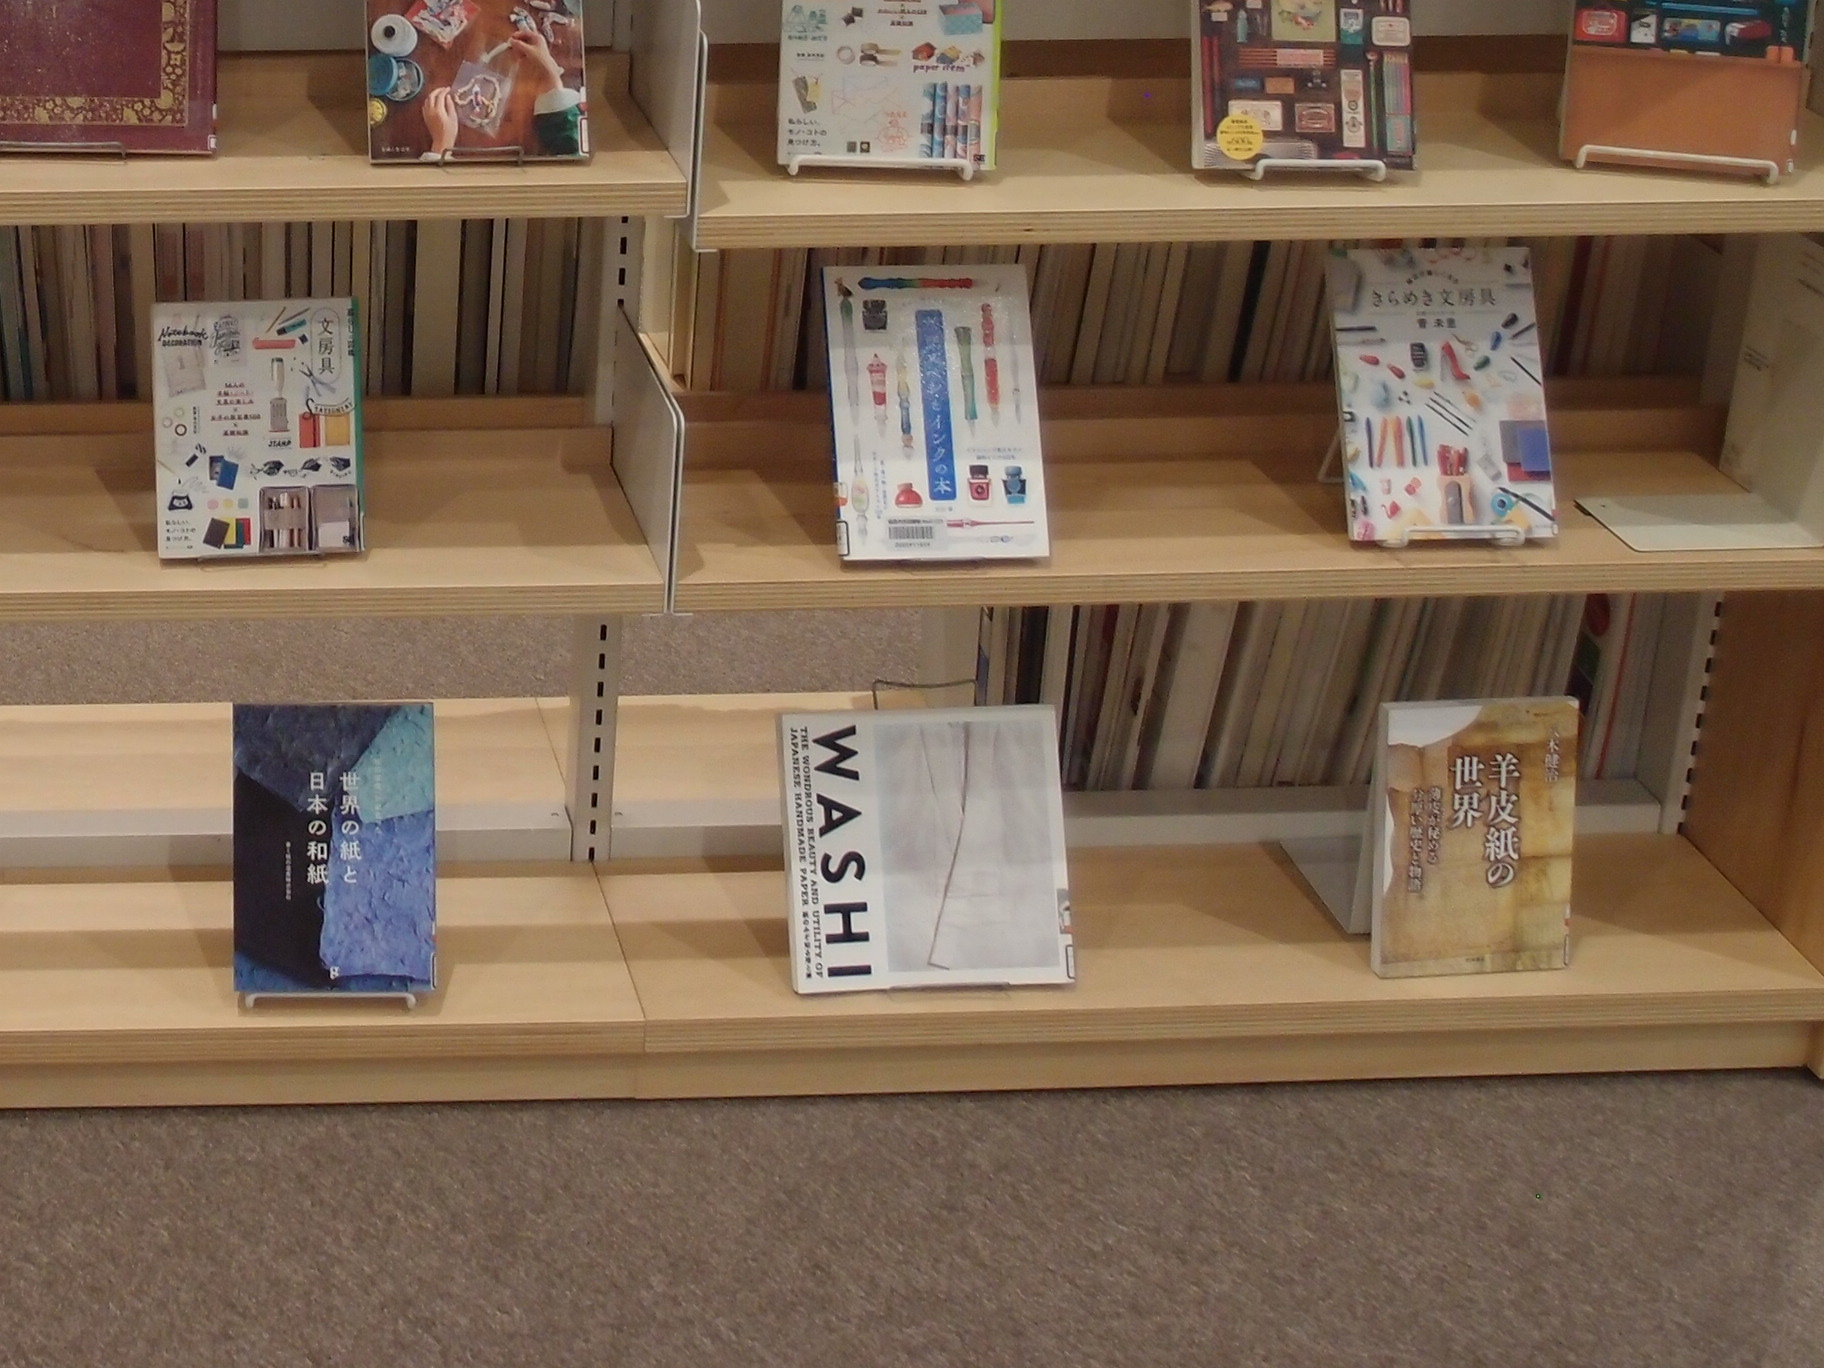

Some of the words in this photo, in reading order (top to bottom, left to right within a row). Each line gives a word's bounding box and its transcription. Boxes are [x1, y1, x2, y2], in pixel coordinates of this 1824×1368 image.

[1371, 288, 1497, 308] きらめき文房具
[317, 317, 336, 375] 文房具
[789, 727, 801, 789] JAPANESE
[799, 726, 808, 750] THE
[801, 754, 814, 824] WONDROUS
[1449, 755, 1486, 829] 世界
[306, 771, 329, 885] 日本の和紙
[339, 771, 363, 884] 世界の紙と
[794, 792, 807, 863] HANDMADE
[1485, 752, 1521, 889] 羊皮紙の
[807, 827, 818, 875] BEAUTY
[811, 724, 873, 979] WASHI
[799, 867, 809, 907] PAPER
[810, 879, 820, 906] AND
[812, 910, 823, 959] UTILITY
[814, 962, 824, 979] OF
